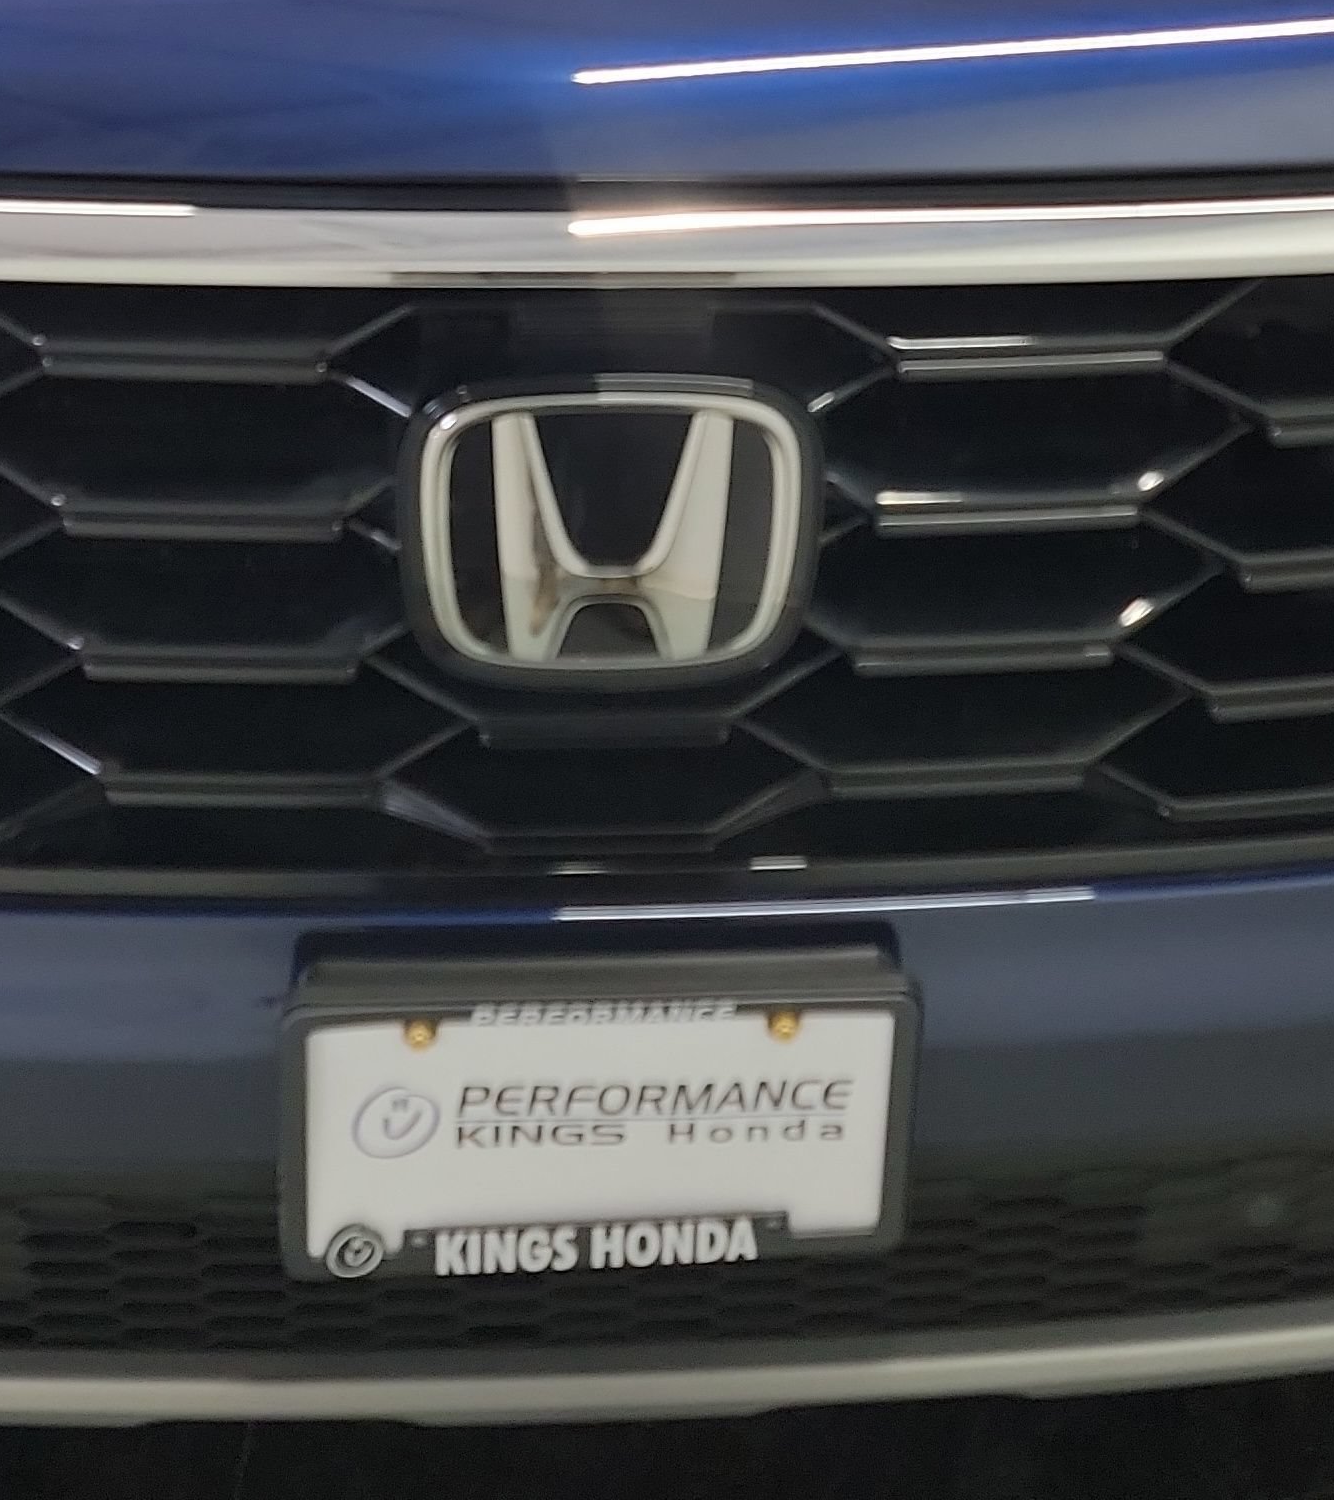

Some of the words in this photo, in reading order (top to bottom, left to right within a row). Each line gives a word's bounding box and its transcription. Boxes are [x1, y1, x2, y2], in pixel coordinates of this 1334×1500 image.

[459, 1079, 855, 1117] PERFORMANCE
[457, 1123, 627, 1149] KINGS
[667, 1119, 845, 1145] Honda
[434, 1226, 579, 1277] KINGS
[589, 1216, 759, 1269] HONDA
